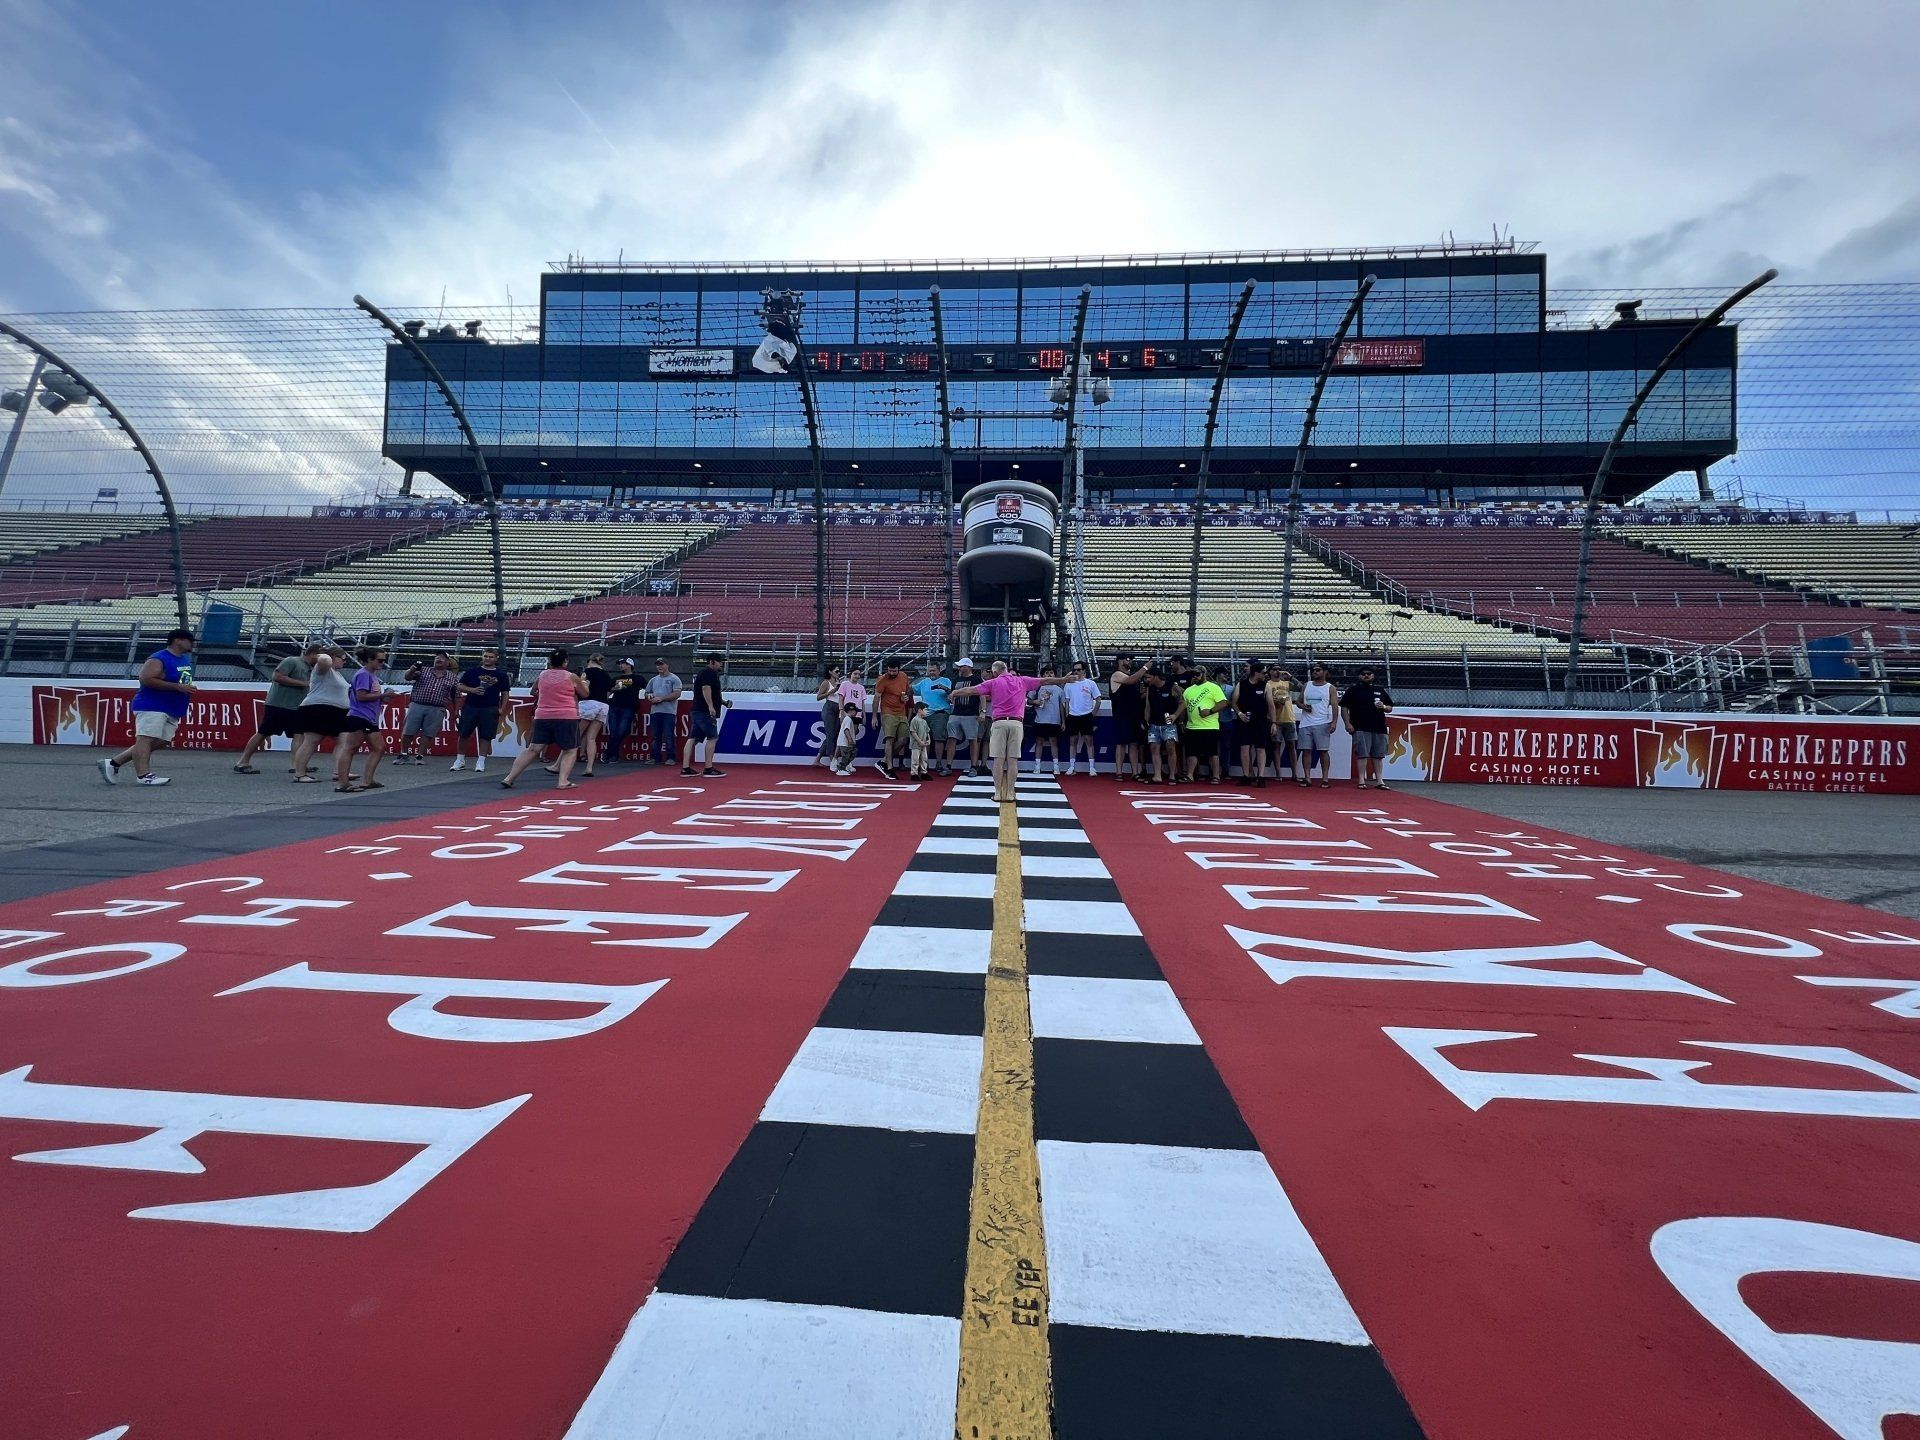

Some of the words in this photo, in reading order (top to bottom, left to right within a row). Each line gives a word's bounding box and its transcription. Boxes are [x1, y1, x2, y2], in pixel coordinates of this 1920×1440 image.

[818, 352, 840, 370] 91
[897, 357, 904, 365] 3
[1031, 356, 1037, 364] 6
[1040, 350, 1063, 368] 08
[1098, 349, 1109, 368] 4
[1122, 354, 1128, 362] 8
[1144, 348, 1155, 367] 6
[1169, 353, 1175, 361] 9
[340, 509, 357, 518] ally
[386, 509, 403, 519] ally
[431, 509, 448, 520] ally
[523, 512, 540, 521] ally
[573, 512, 589, 522] ally
[619, 513, 636, 523] ally
[666, 513, 682, 523] ally
[714, 513, 730, 524] ally
[761, 513, 778, 524] ally
[1827, 513, 1850, 524] ally
[860, 515, 877, 525] ally
[909, 515, 925, 526] ally
[1109, 516, 1127, 527] ally
[1160, 516, 1178, 527] ally
[1212, 516, 1229, 527] ally
[1264, 516, 1282, 527] ally
[1319, 516, 1338, 527] ally
[1372, 516, 1391, 527] ally
[1426, 515, 1444, 527] ally
[1480, 515, 1500, 527] ally
[1536, 515, 1556, 526] ally
[1652, 514, 1672, 526] ally
[1709, 514, 1731, 525] ally
[1769, 514, 1790, 525] ally
[113, 697, 242, 726] FIEPERS
[187, 730, 228, 740] HOTEL
[182, 741, 212, 749] CREEK
[1454, 728, 1619, 760] FIREKEEPERS
[1732, 734, 1907, 767] FIREKEEPERS
[1469, 762, 1533, 773] CASINO
[1548, 764, 1601, 776] HOTEL
[1488, 775, 1532, 784] BATTLE
[1541, 776, 1580, 785] CREEK
[1748, 769, 1816, 781] CASINO
[1831, 770, 1888, 782] HOTEL
[1768, 782, 1815, 792] BATTLE
[1825, 783, 1866, 793] CREEK
[325, 798, 587, 856] BATTLE
[430, 786, 706, 860] CASINO
[1336, 807, 1595, 880] HOTEL
[1475, 830, 1744, 898] CREEK
[0, 780, 922, 1440] FIREKEEPE
